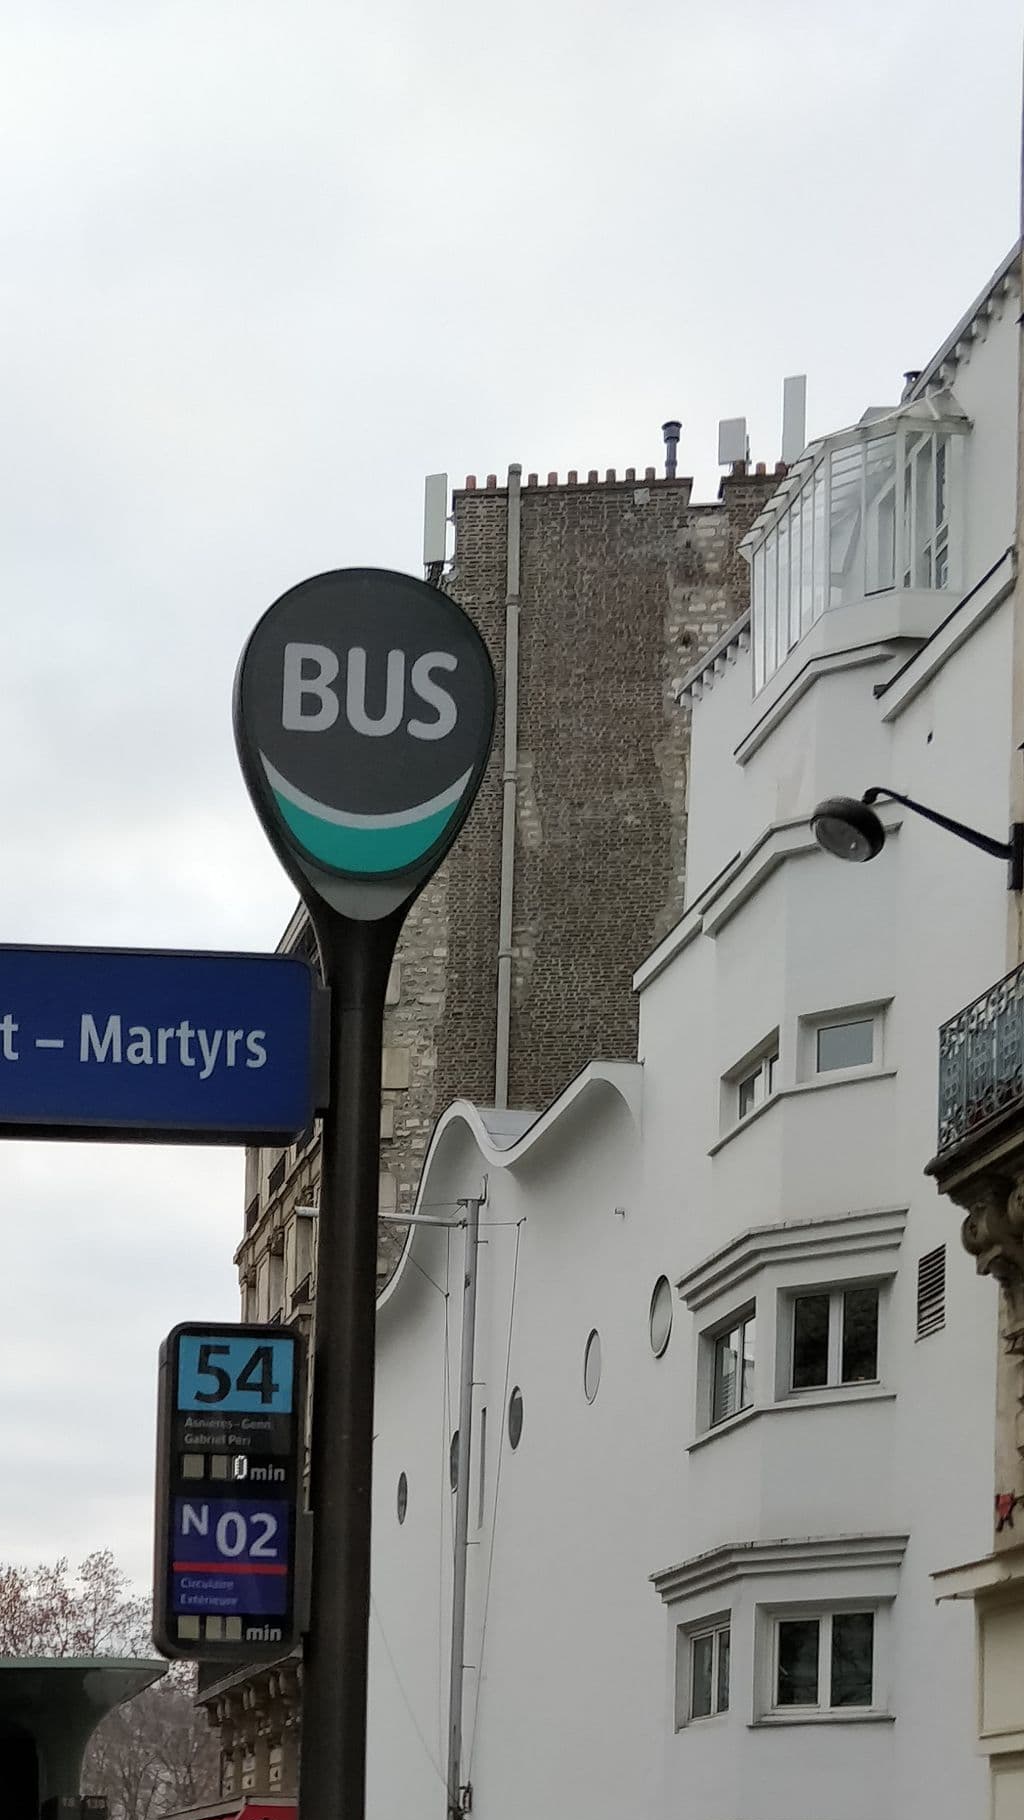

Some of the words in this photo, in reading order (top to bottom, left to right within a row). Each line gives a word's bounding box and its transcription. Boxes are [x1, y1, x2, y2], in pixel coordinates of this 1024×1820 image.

[281, 641, 458, 741] BUS
[79, 1012, 269, 1080] Martyrs
[194, 1344, 279, 1404] 54
[246, 1624, 282, 1642] min
